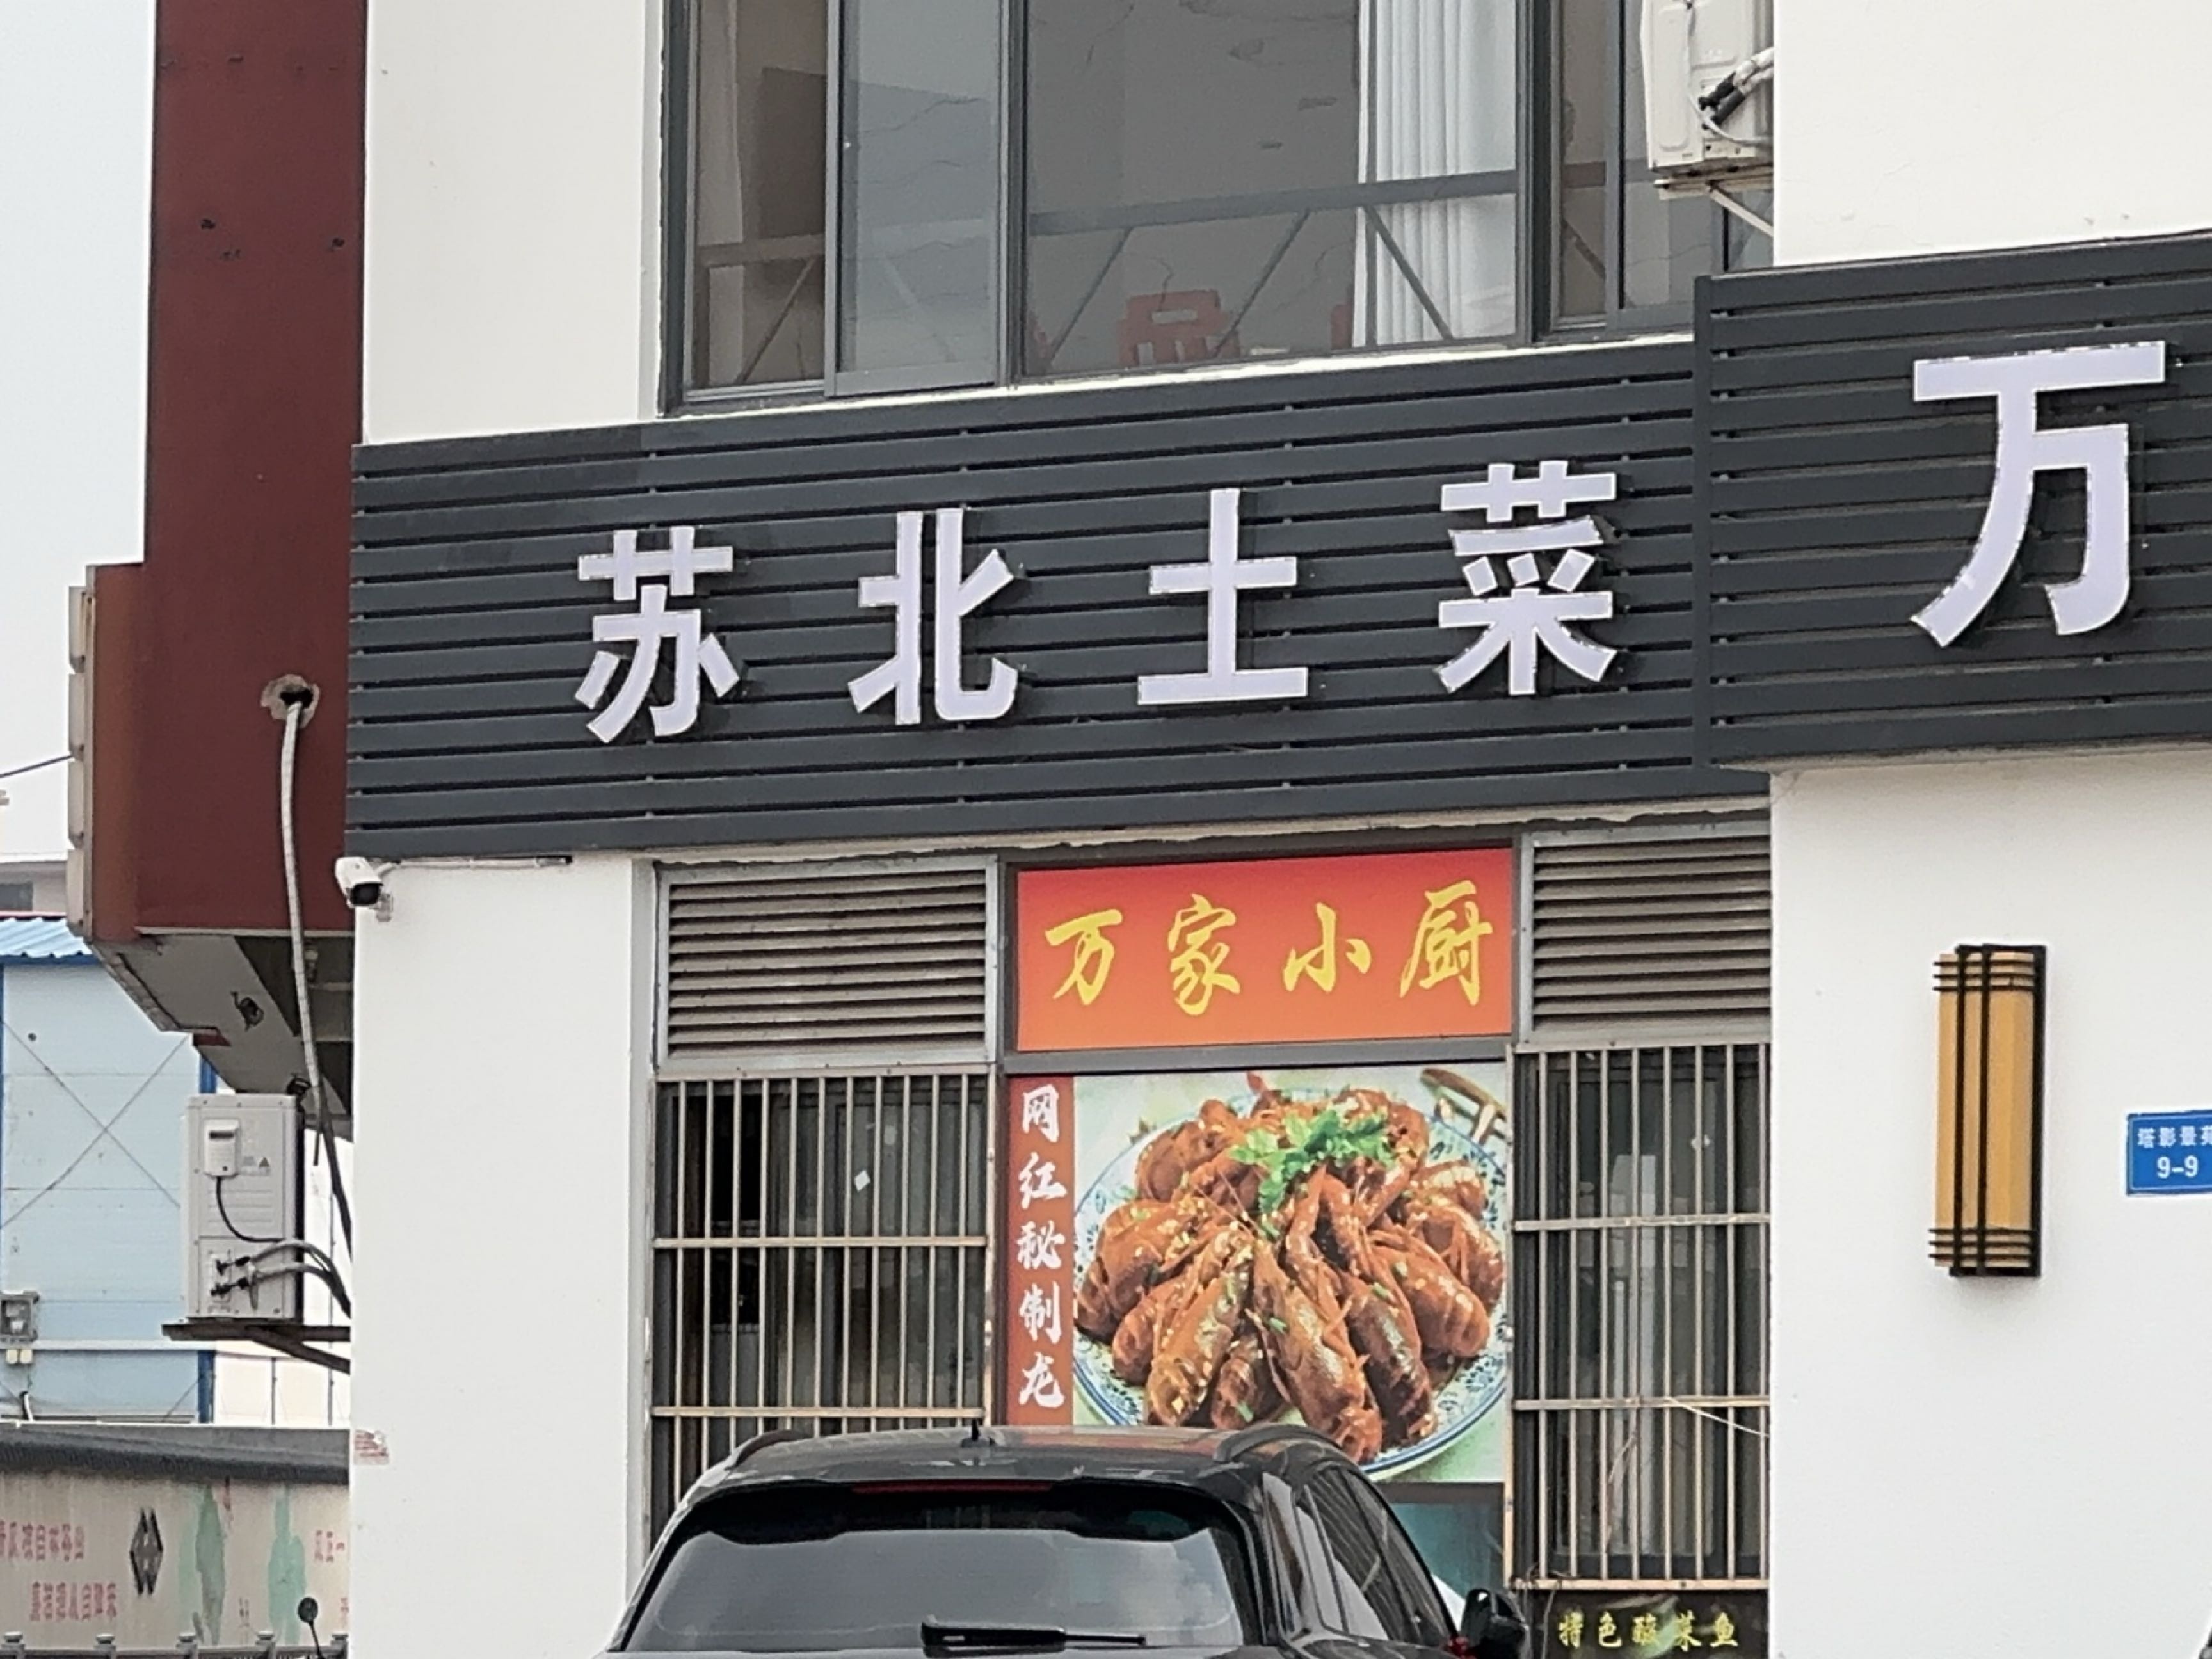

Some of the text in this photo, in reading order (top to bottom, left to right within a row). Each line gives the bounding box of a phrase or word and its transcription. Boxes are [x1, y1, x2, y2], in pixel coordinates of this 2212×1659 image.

[1911, 341, 2166, 648] 万
[575, 460, 1618, 742] 苏北土菜
[1045, 879, 1493, 1016] 万家小厨
[1017, 1084, 1068, 1408] 网红秘制龙
[2156, 1155, 2199, 1179] 9-9
[1558, 1609, 1738, 1651] 特色酸菜鱼
